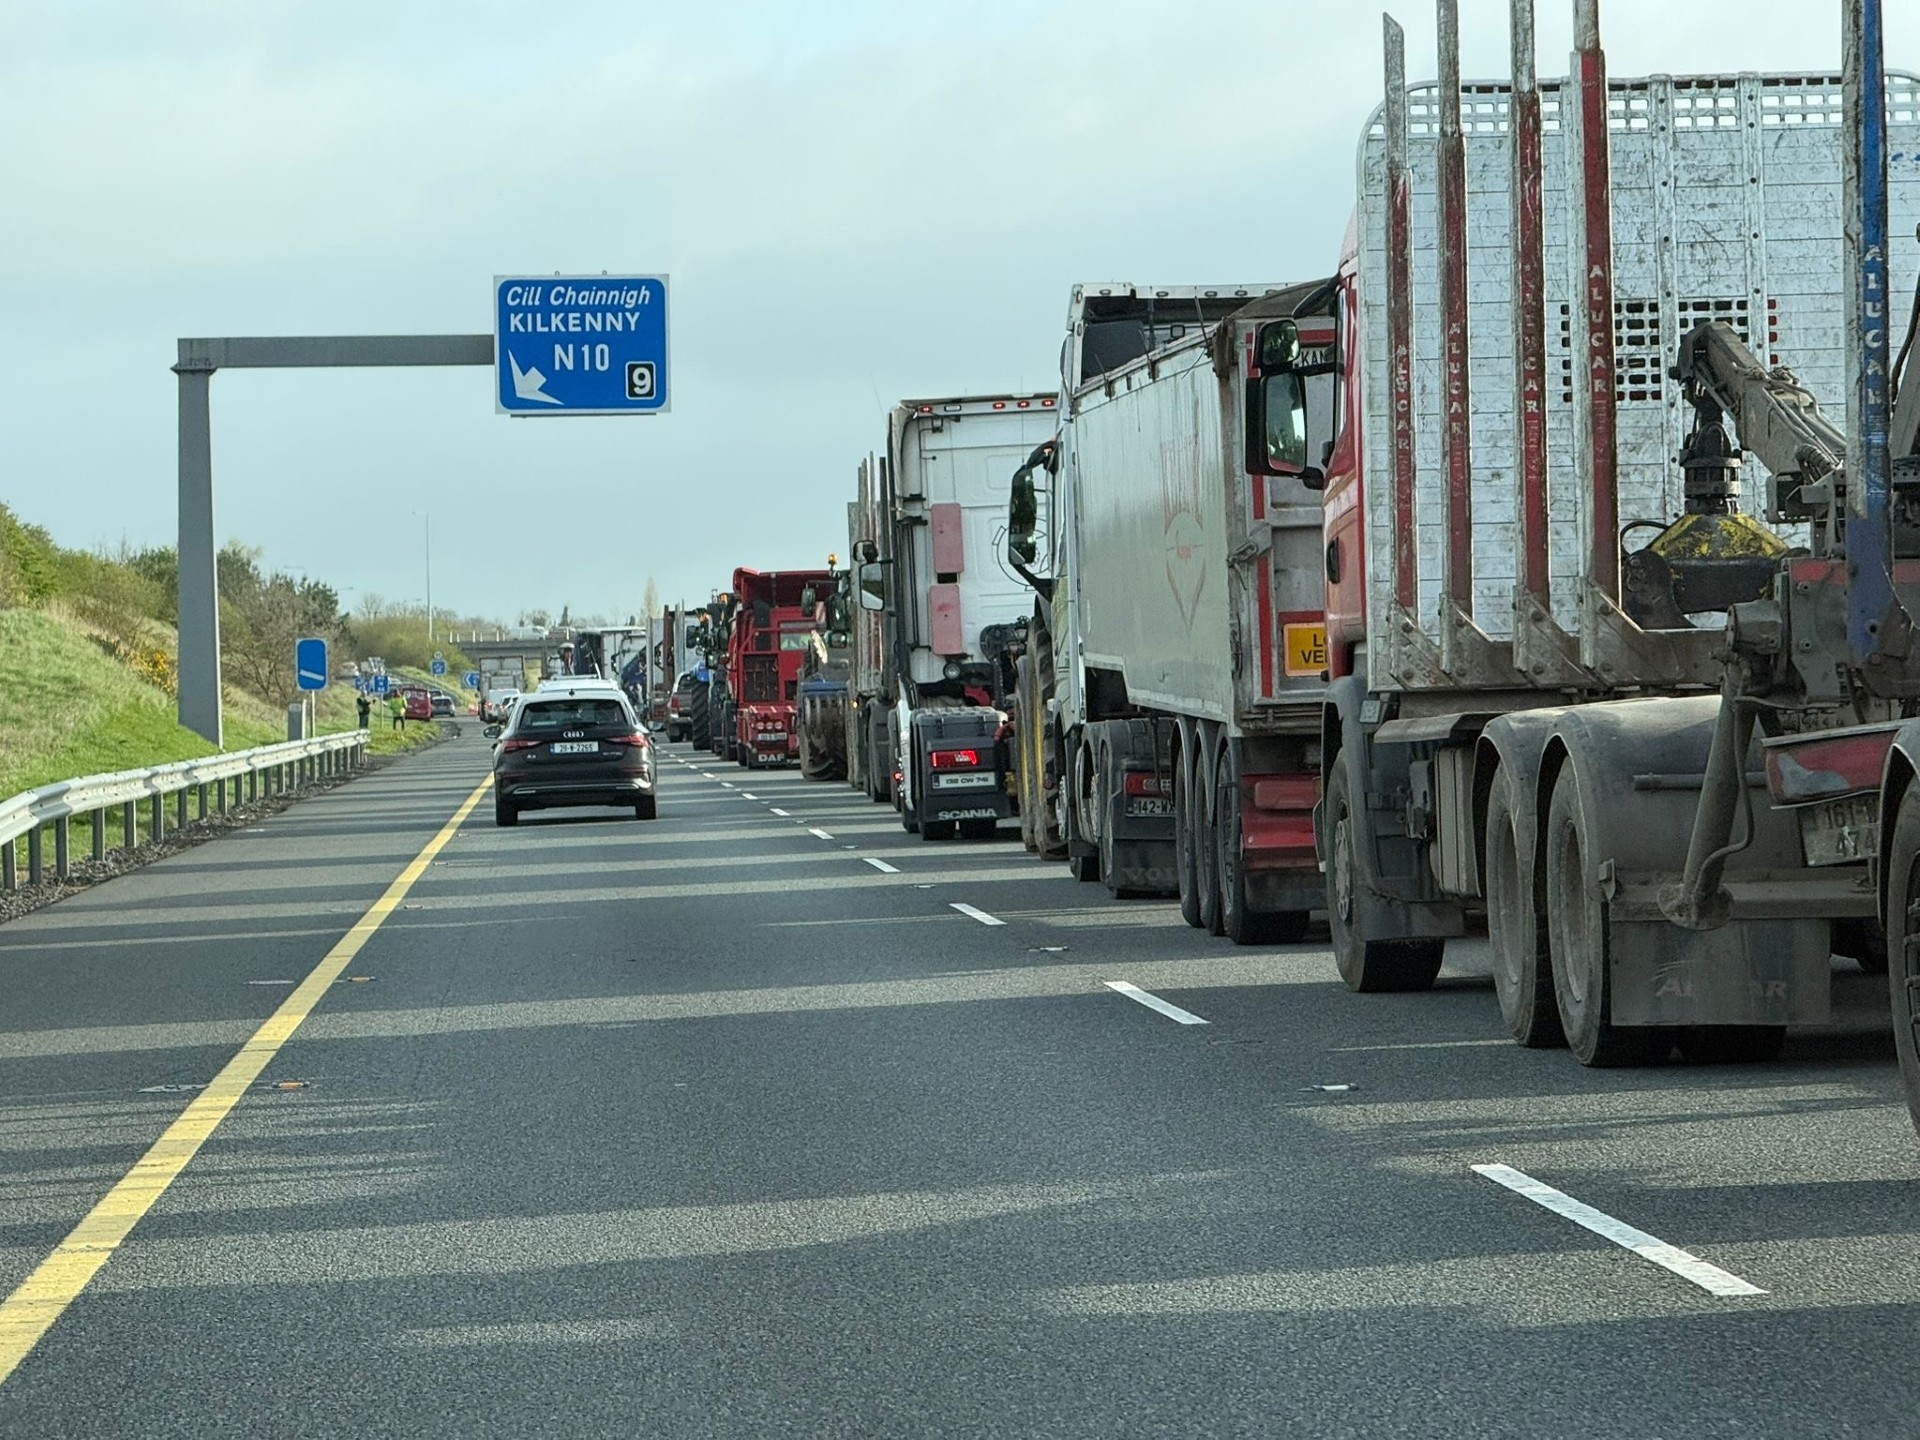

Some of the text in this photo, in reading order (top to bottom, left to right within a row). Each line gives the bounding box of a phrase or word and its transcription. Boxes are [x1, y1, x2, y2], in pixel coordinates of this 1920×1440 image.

[507, 285, 650, 308] Cill Chainnigh
[510, 311, 640, 332] KILKENNY
[1589, 264, 1608, 392] ALUCAR
[1864, 244, 1883, 404] ALUCAR
[554, 343, 610, 372] N10
[632, 366, 652, 395] 9
[1448, 322, 1463, 435] ALUCAR
[1313, 633, 1326, 647] L
[758, 753, 785, 762] DAF
[938, 807, 998, 820] SCANIA
